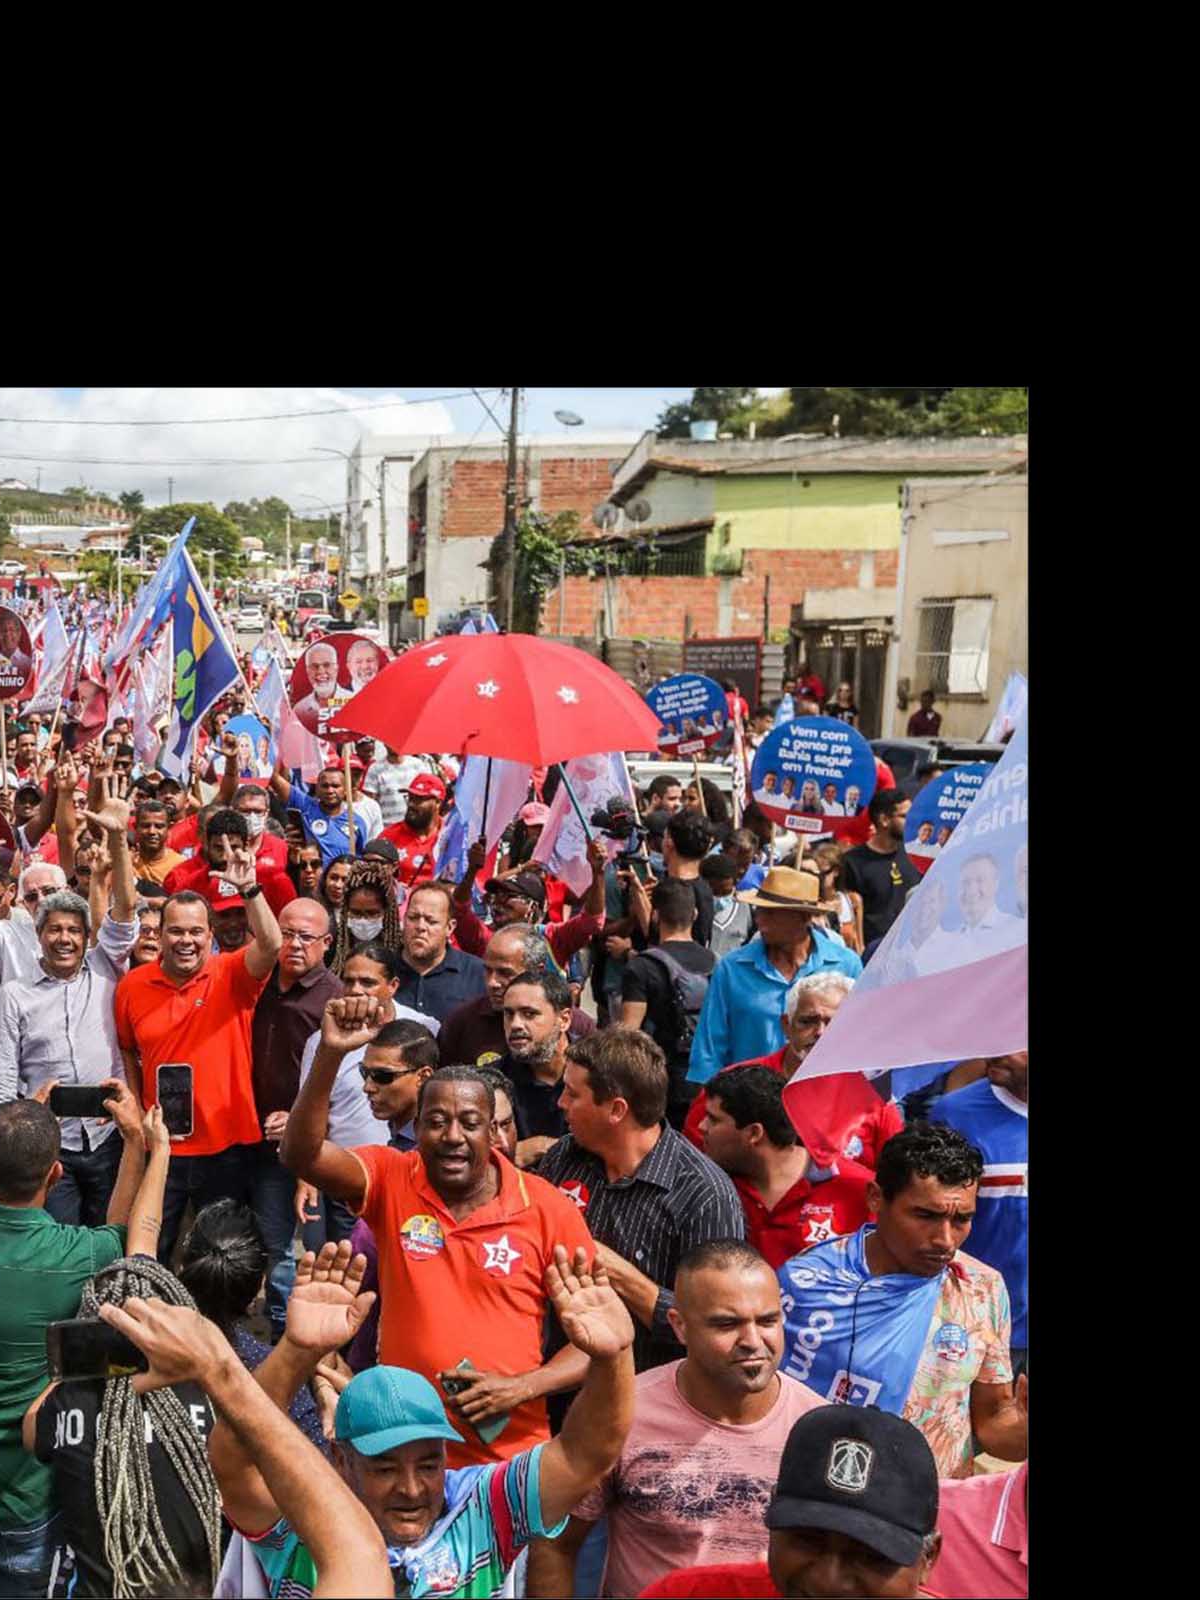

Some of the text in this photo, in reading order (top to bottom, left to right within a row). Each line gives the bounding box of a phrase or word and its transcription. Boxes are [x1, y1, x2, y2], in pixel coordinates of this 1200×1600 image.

[790, 724, 849, 742] Vem com
[782, 737, 853, 755] a gente pra
[778, 747, 853, 767] Bahia seguir
[781, 762, 802, 773] em
[954, 771, 983, 784] Vem
[943, 785, 977, 800] a gen
[940, 810, 962, 821] em
[814, 1226, 829, 1240] 13
[492, 1247, 510, 1264] 13
[784, 1309, 834, 1381] com
[53, 1408, 85, 1449] NO
